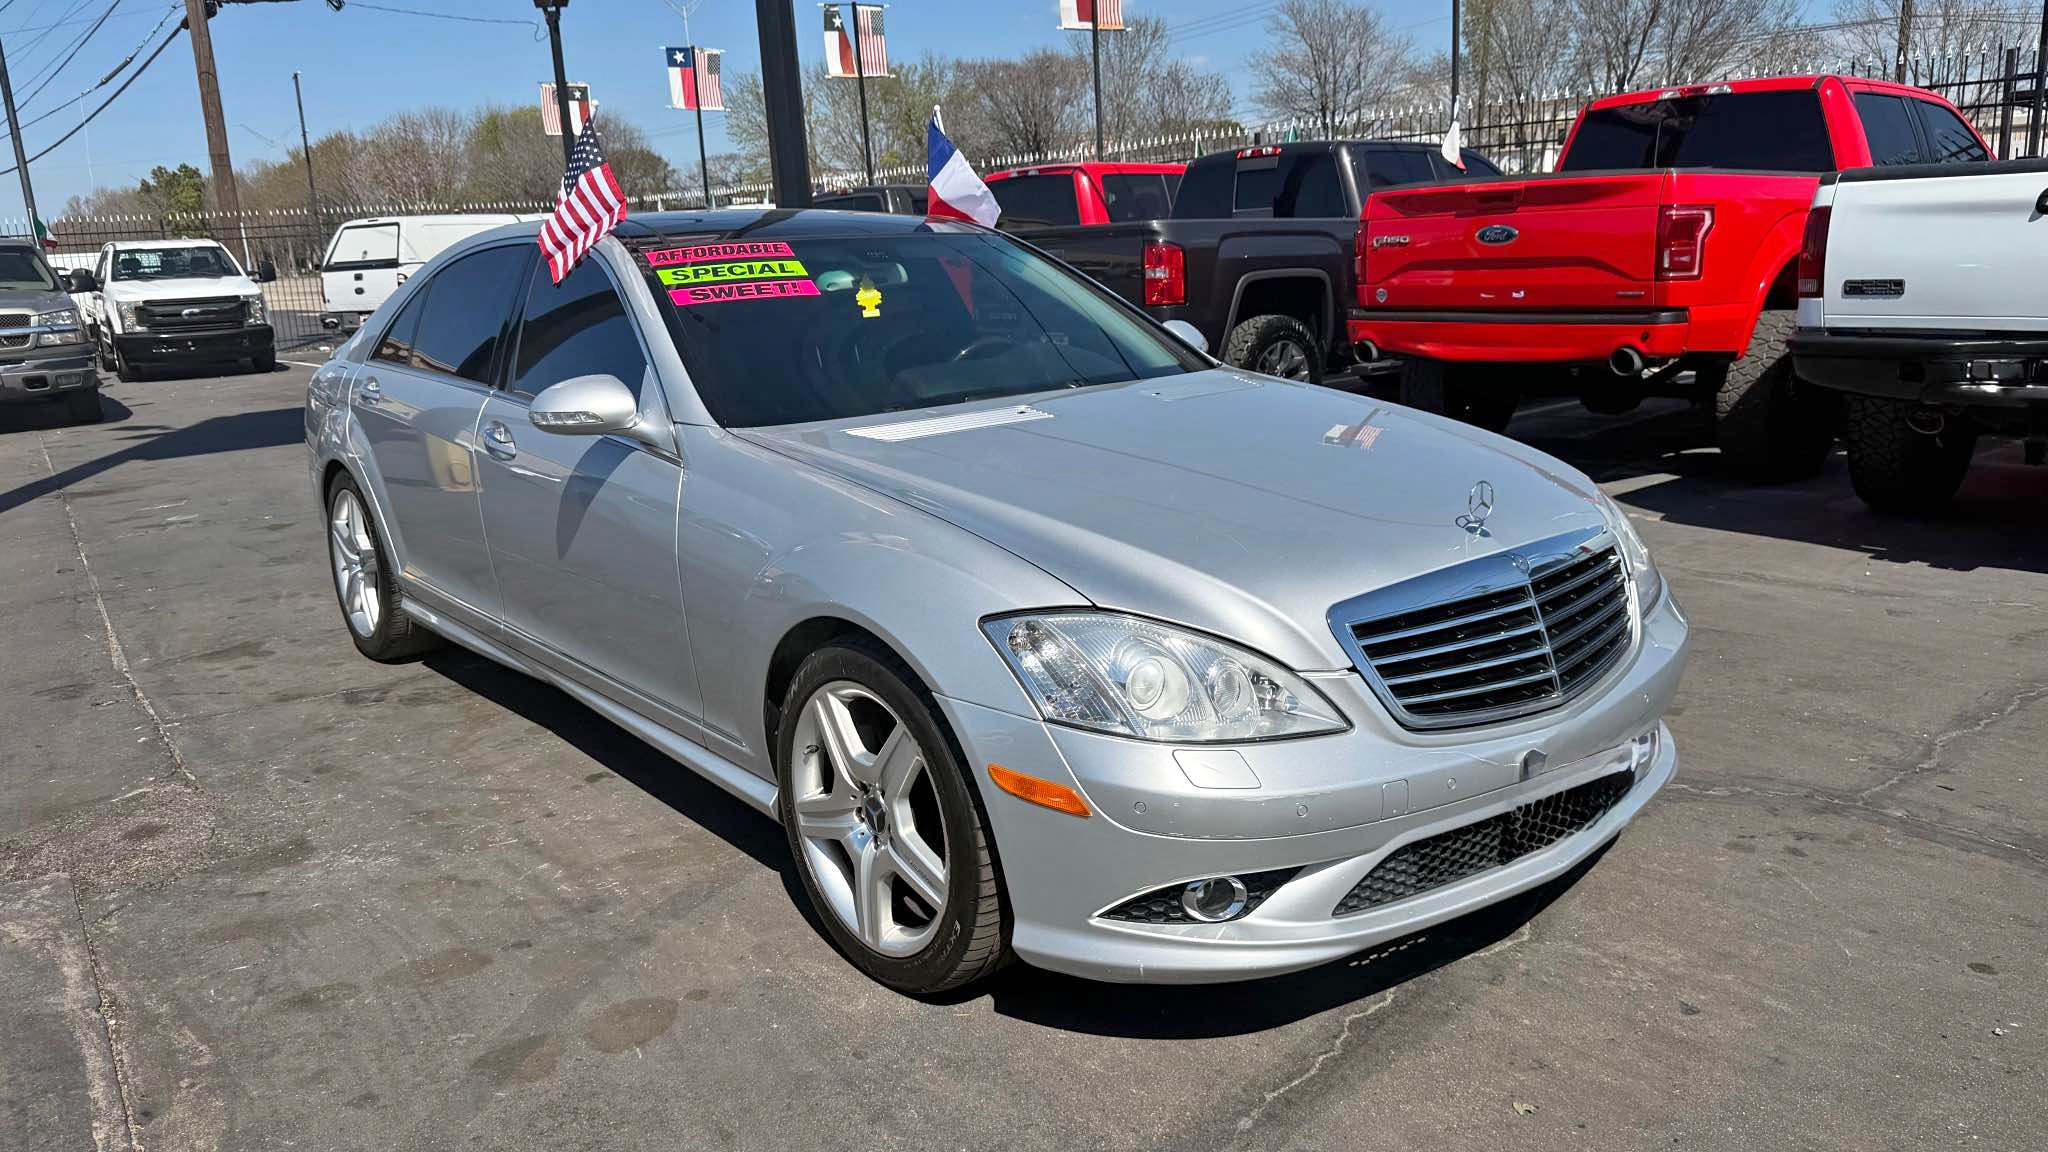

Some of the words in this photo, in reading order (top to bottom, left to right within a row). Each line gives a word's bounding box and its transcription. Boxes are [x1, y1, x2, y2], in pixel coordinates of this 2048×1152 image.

[1483, 229, 1508, 241] Ford
[655, 242, 785, 262] AFFORDABLE
[671, 263, 795, 281] SPECIAL
[688, 281, 801, 301] SWEET!
